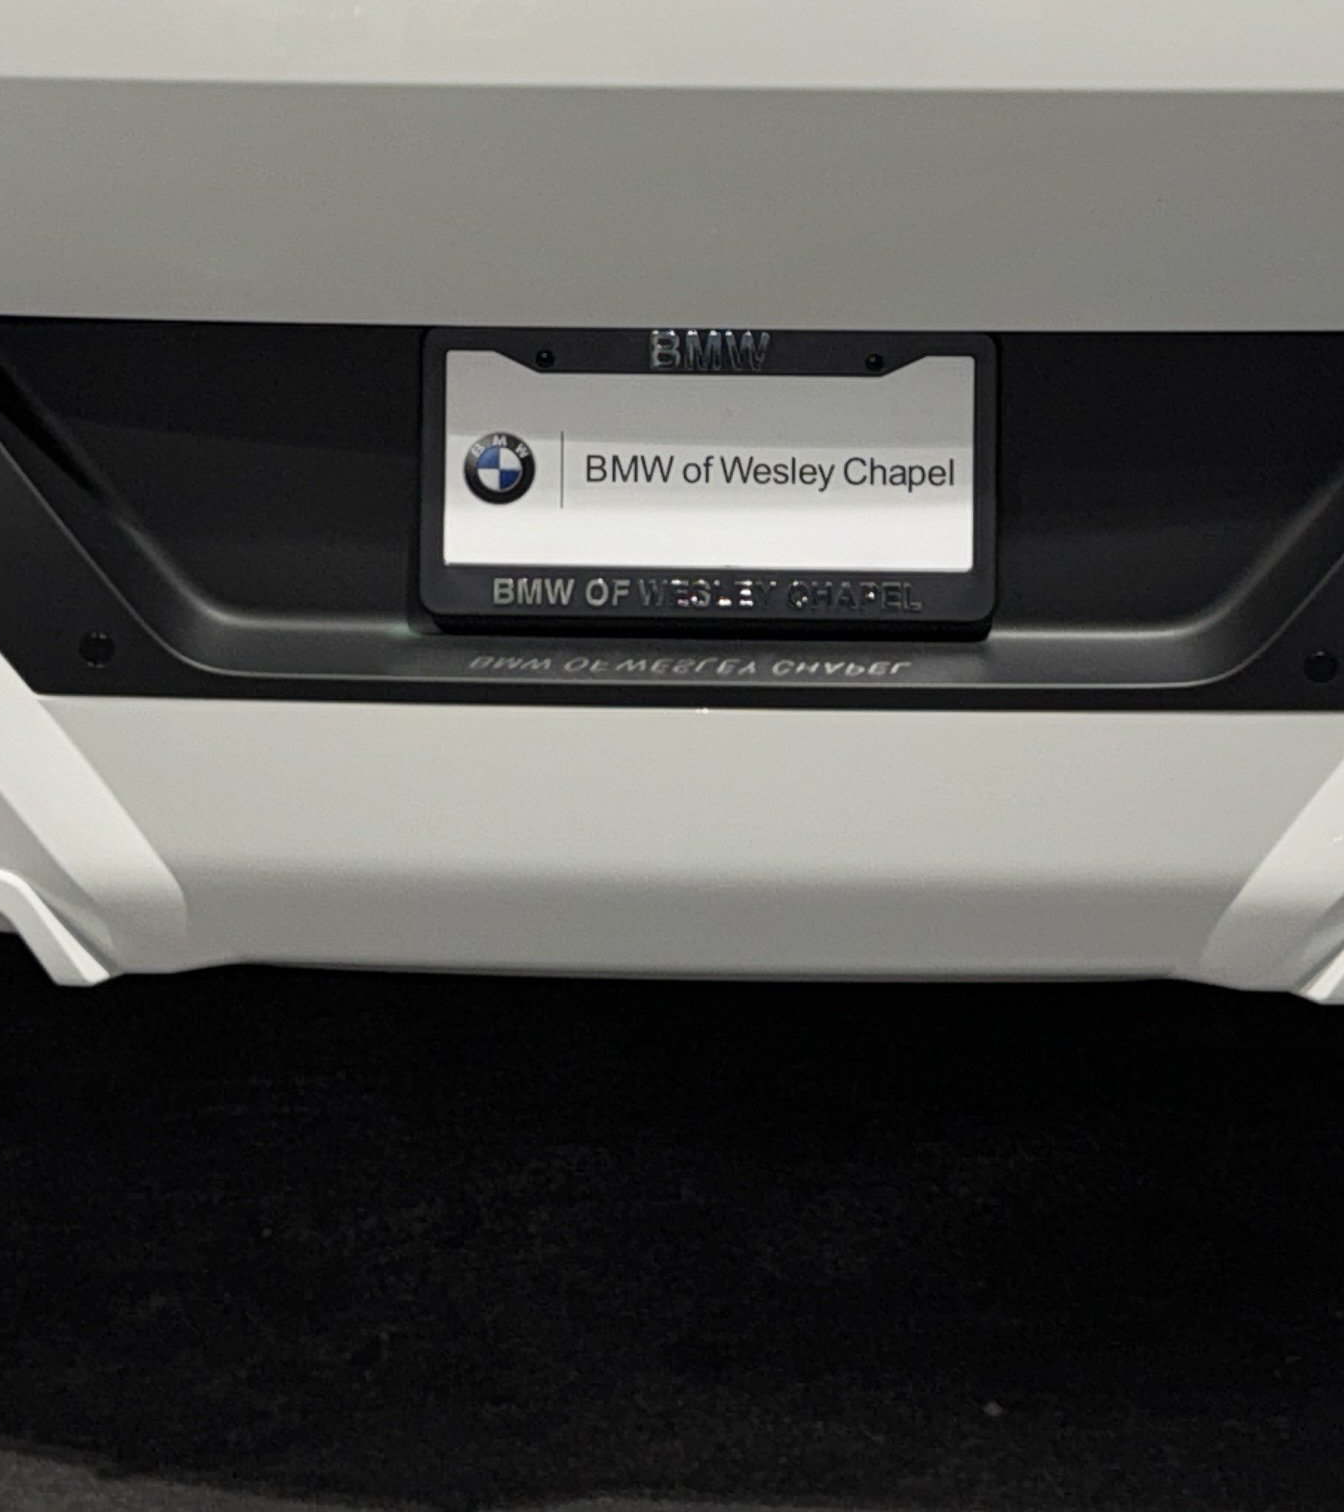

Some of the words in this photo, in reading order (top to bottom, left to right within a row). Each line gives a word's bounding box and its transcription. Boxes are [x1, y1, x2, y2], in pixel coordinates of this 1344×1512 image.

[649, 329, 770, 372] BMW
[585, 454, 674, 483] BMW
[682, 455, 714, 484] of
[719, 455, 836, 492] Wesley
[843, 456, 955, 493] Chapel
[492, 576, 575, 607] BMW
[585, 578, 631, 608] OF
[638, 578, 778, 609] WESLEY
[788, 580, 923, 612] CHAPEL
